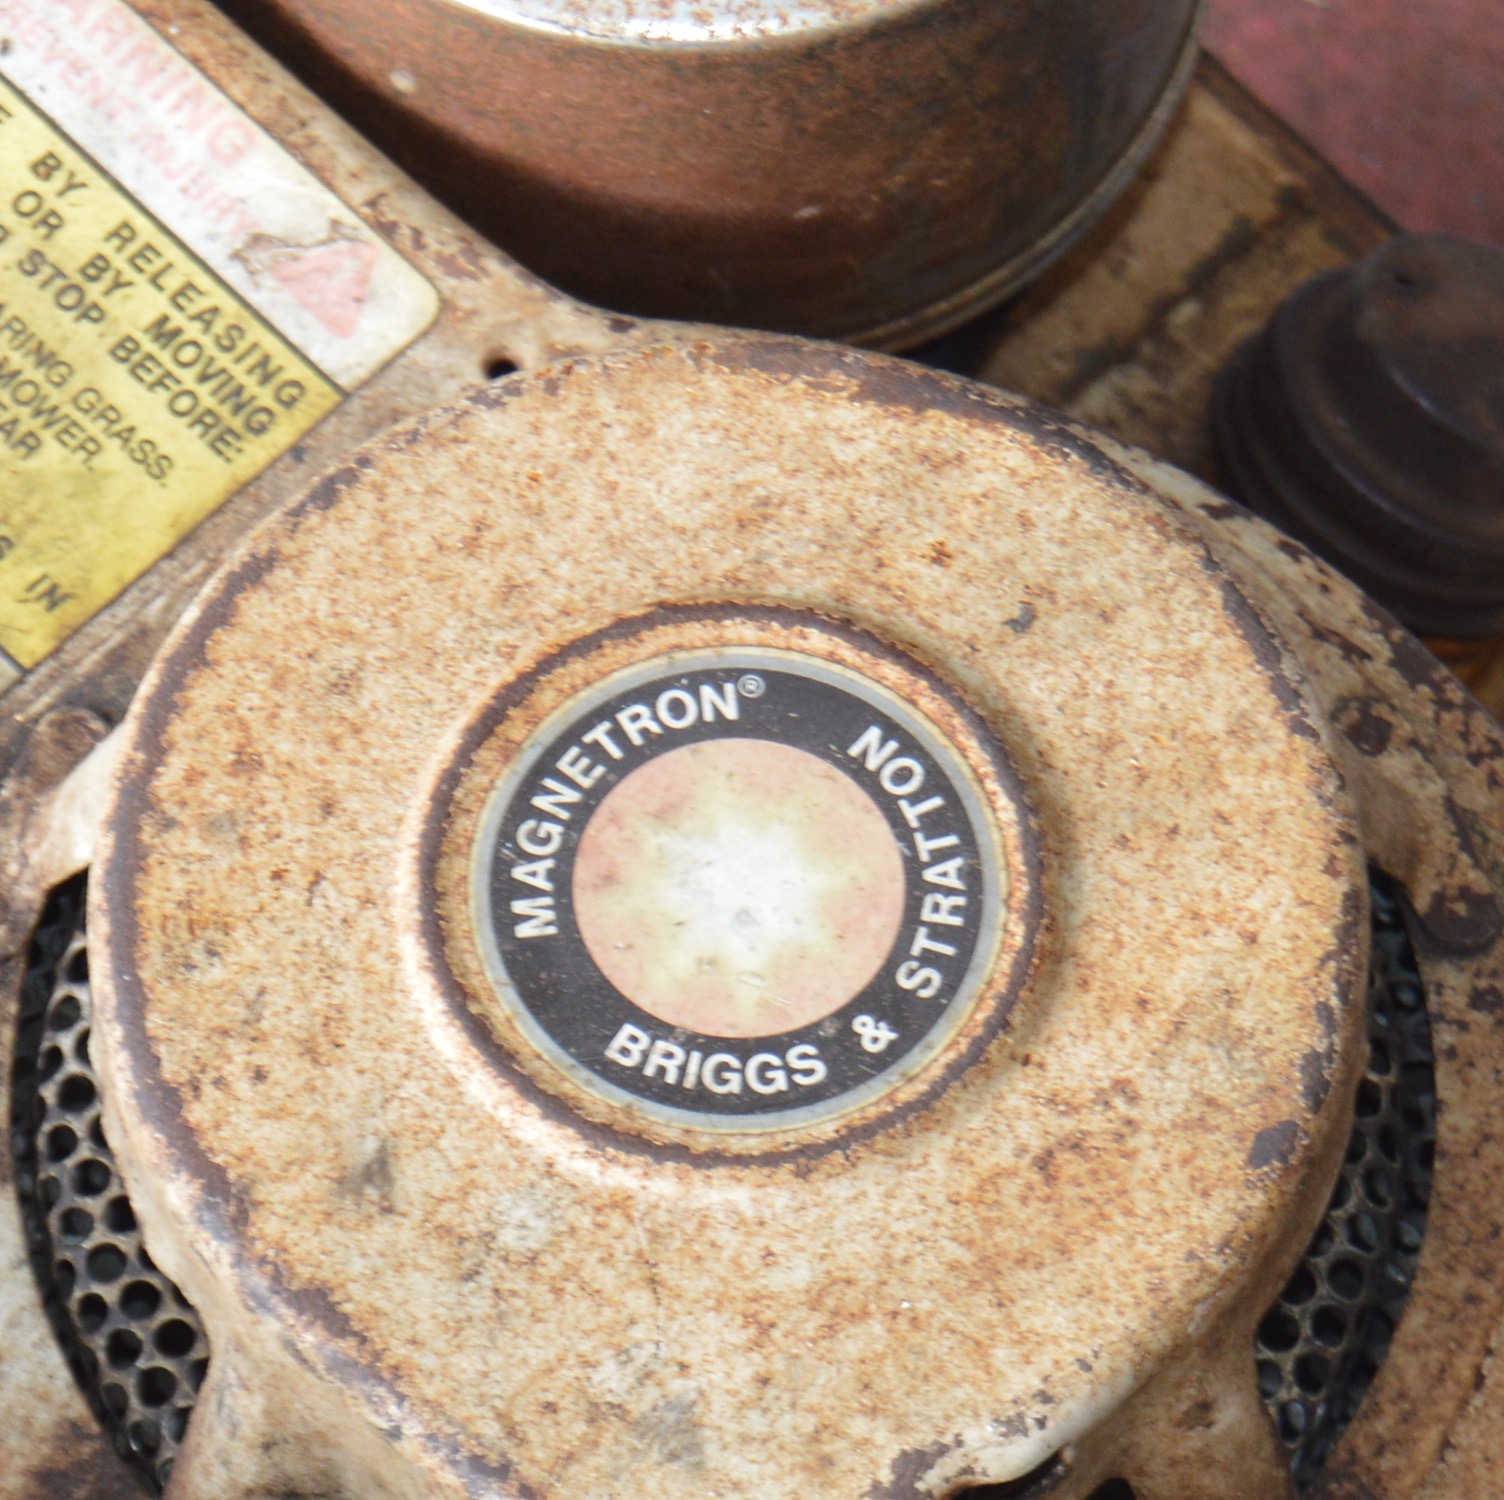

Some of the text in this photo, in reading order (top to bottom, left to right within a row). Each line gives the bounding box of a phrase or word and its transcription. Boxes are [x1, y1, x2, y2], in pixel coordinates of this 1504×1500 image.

[28, 150, 90, 199] BY
[102, 219, 307, 412] RELEASING
[129, 124, 262, 239] INJURY
[11, 189, 66, 242] OR
[77, 251, 136, 298] BY
[142, 312, 277, 438] MOVING
[15, 247, 107, 325] STOP
[107, 333, 245, 465] BEFORE:
[70, 386, 175, 488] GRASS.
[23, 572, 77, 613] IN
[603, 725, 968, 1095] BRIGGS & STRATTON
